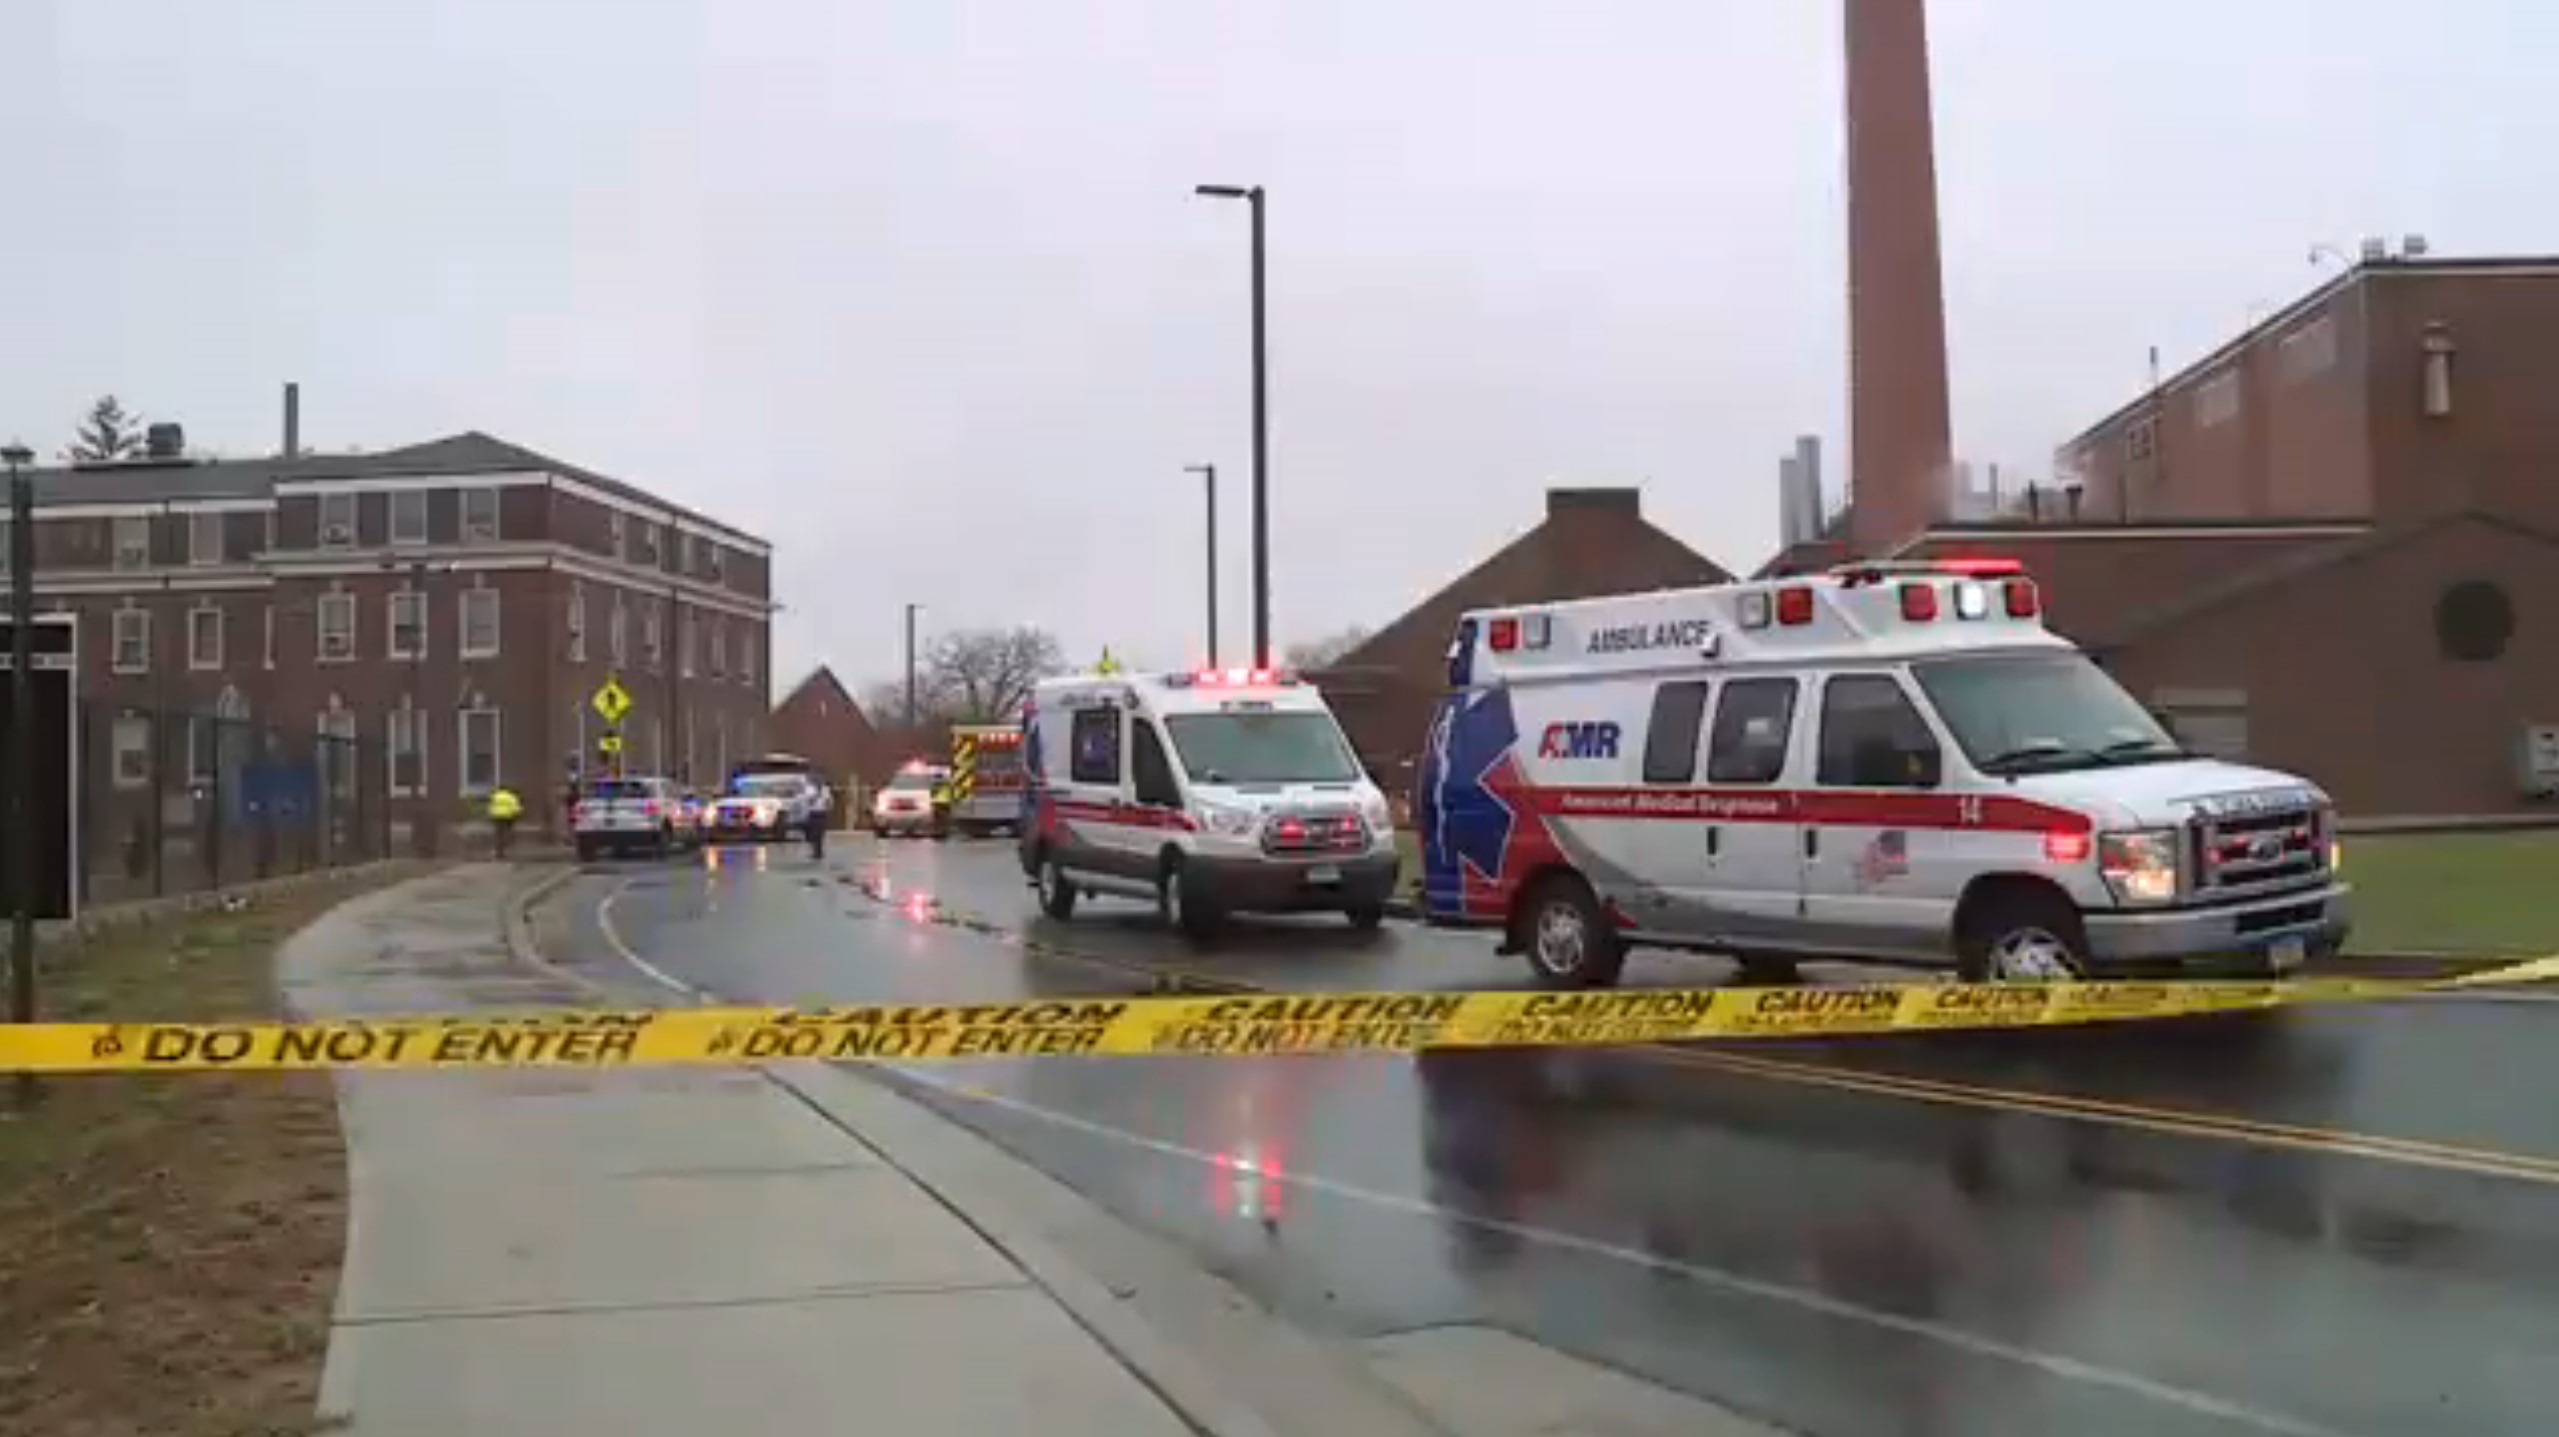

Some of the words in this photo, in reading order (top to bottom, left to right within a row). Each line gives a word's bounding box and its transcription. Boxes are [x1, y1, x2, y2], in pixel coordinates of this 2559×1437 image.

[1585, 619, 1712, 653] AMBULANCE
[1537, 720, 1622, 759] AMR
[1208, 998, 1463, 1021] CAUTION
[1521, 991, 1715, 1017] CAUTION
[142, 1027, 254, 1061] DO
[273, 1026, 421, 1061] NOT
[430, 1026, 638, 1061] ENTER
[743, 1027, 825, 1057] DO
[832, 1026, 948, 1057] NOT
[948, 1026, 1105, 1057] ENTER
